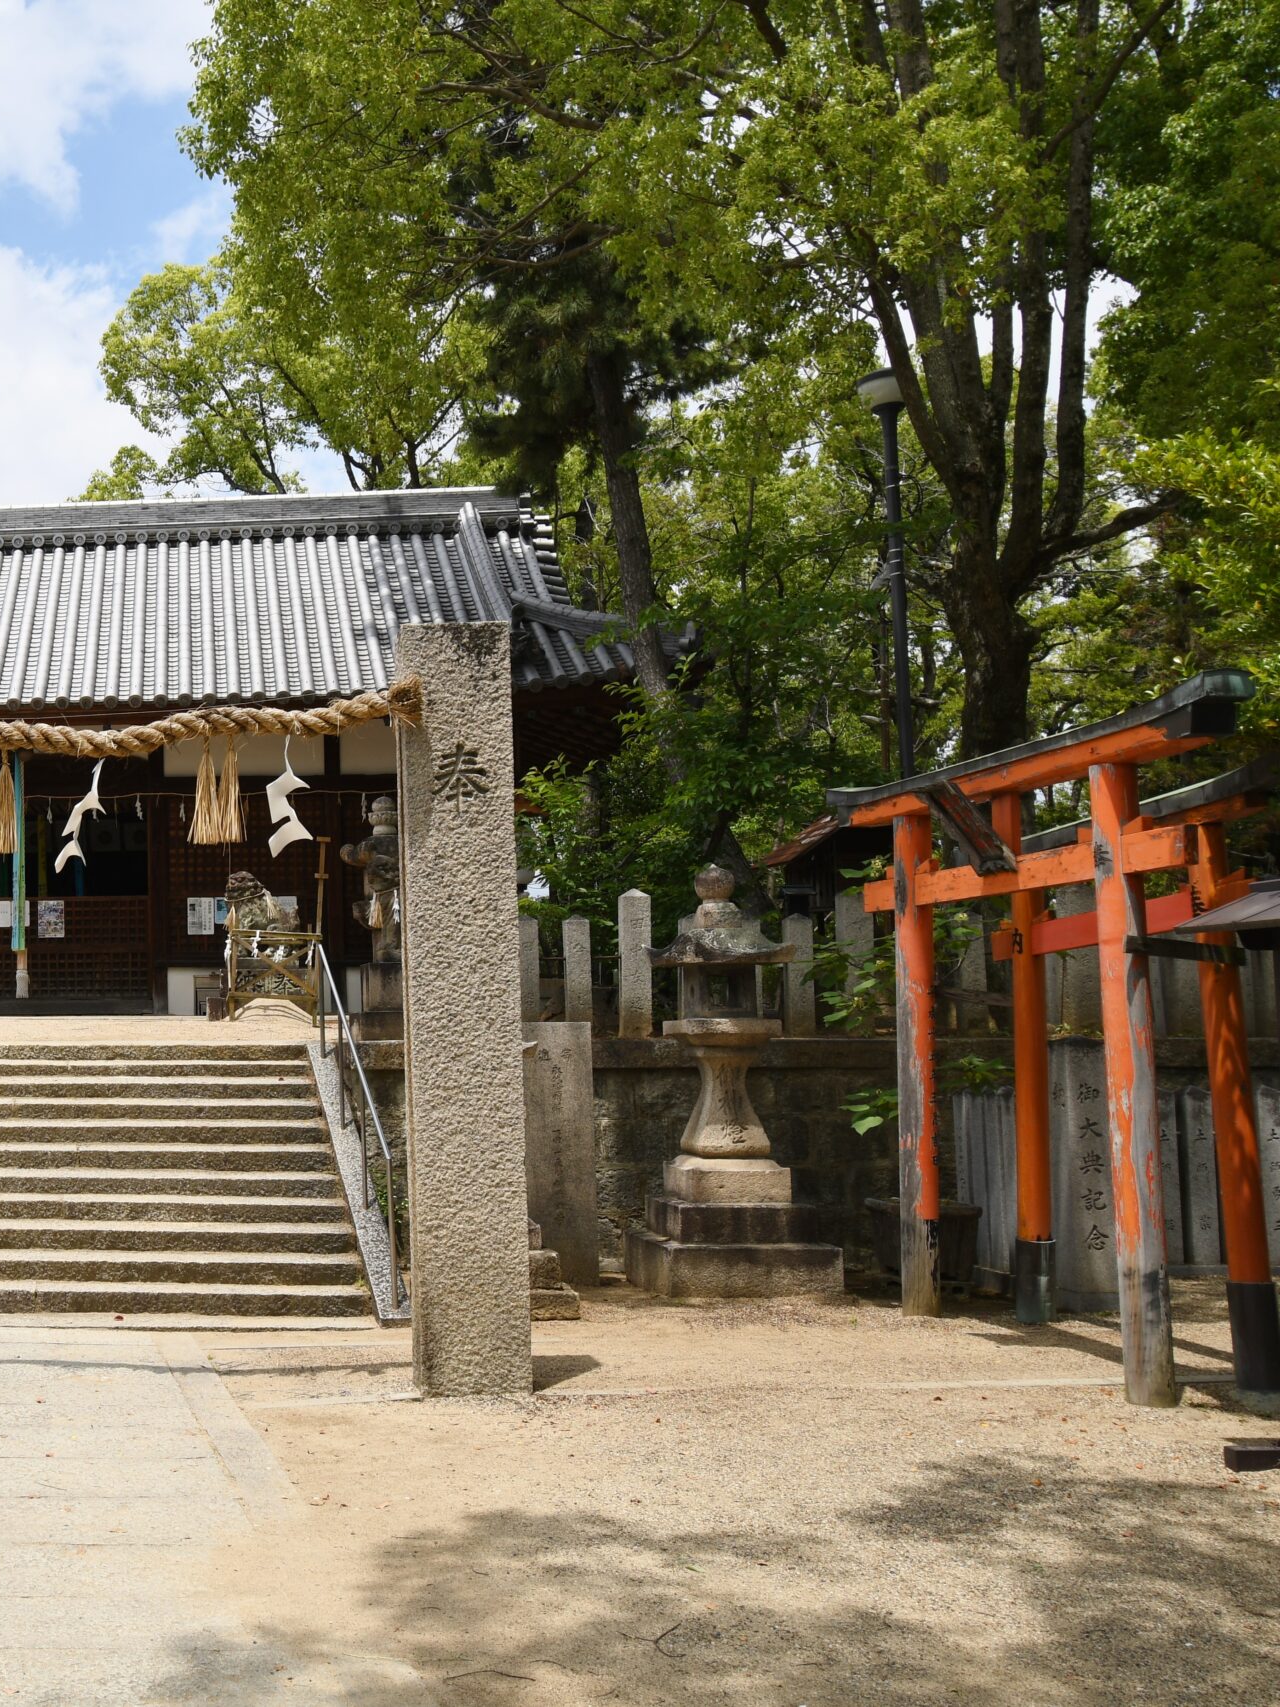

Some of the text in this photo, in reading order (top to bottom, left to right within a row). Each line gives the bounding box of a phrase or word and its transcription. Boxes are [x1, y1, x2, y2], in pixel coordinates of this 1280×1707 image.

[431, 741, 489, 815] 奉
[1076, 1083, 1111, 1251] 御大典記念
